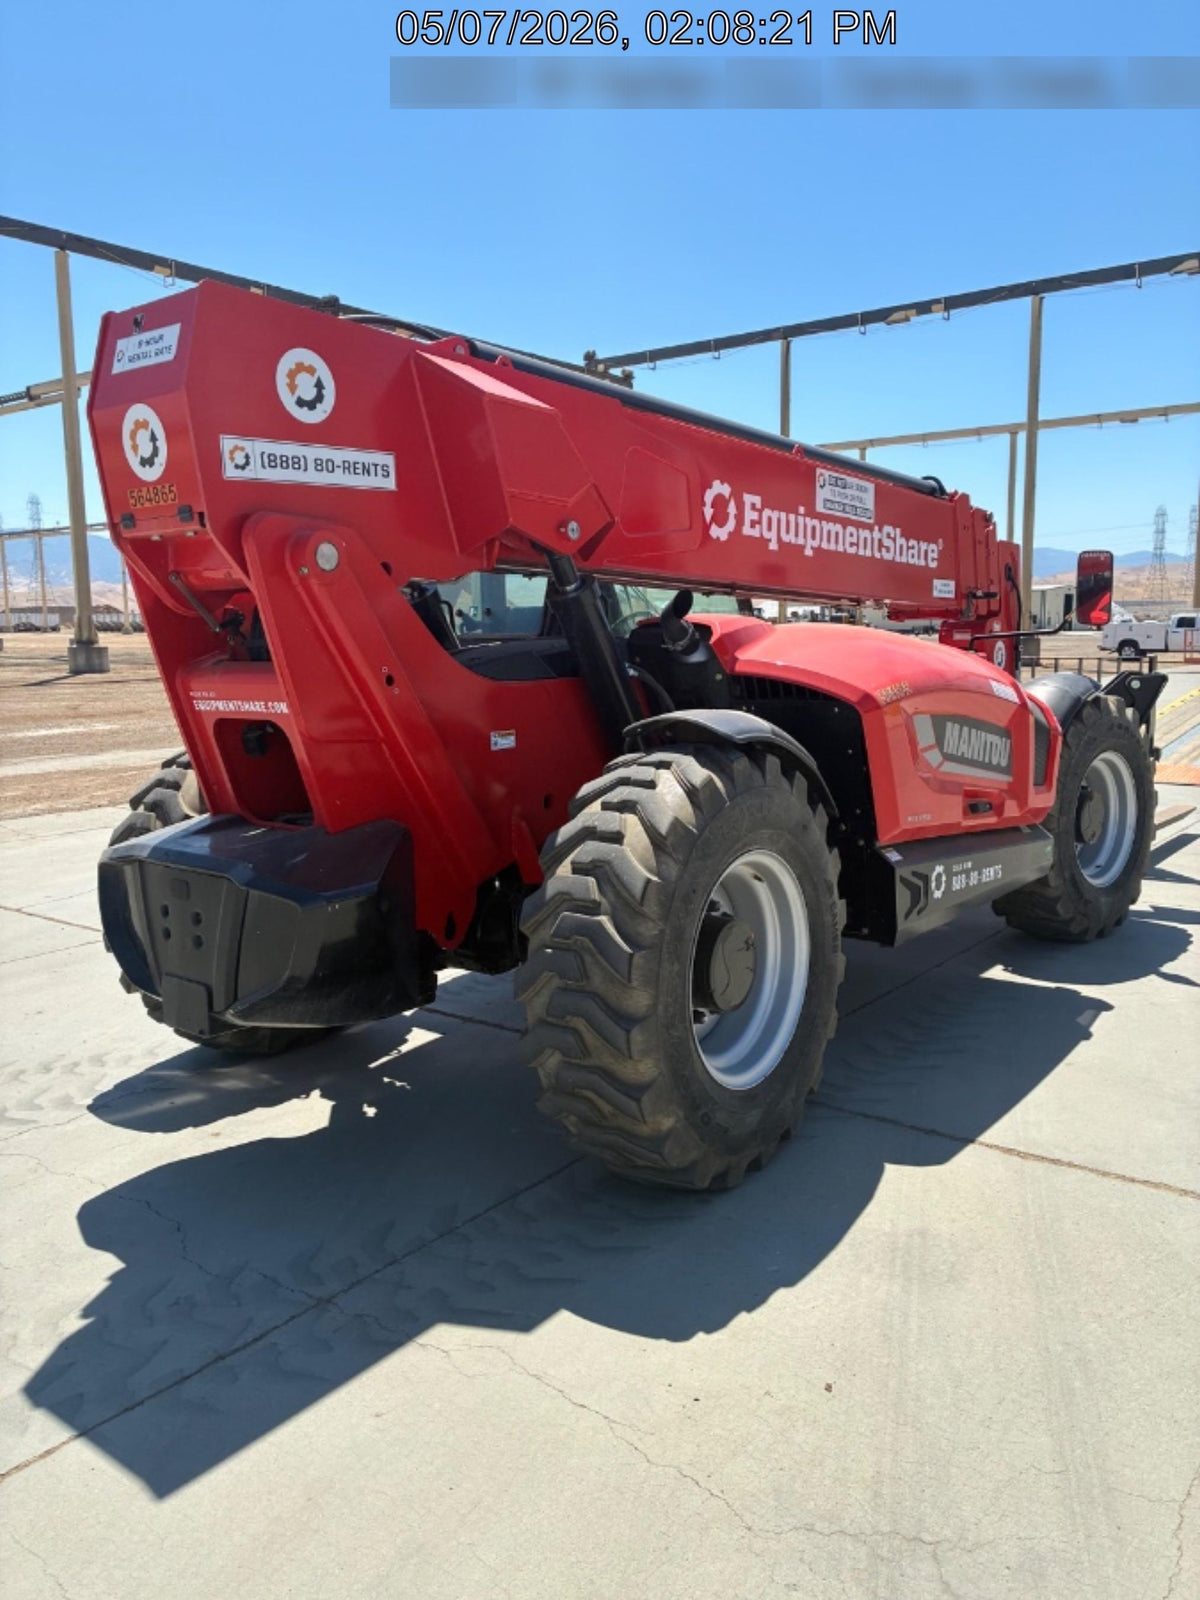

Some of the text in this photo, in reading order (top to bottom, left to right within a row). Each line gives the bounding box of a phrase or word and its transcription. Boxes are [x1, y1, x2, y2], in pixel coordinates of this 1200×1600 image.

[260, 451, 391, 479] (888) 80-RENTS
[129, 483, 177, 508] 564865
[943, 721, 1010, 767] MANITOU
